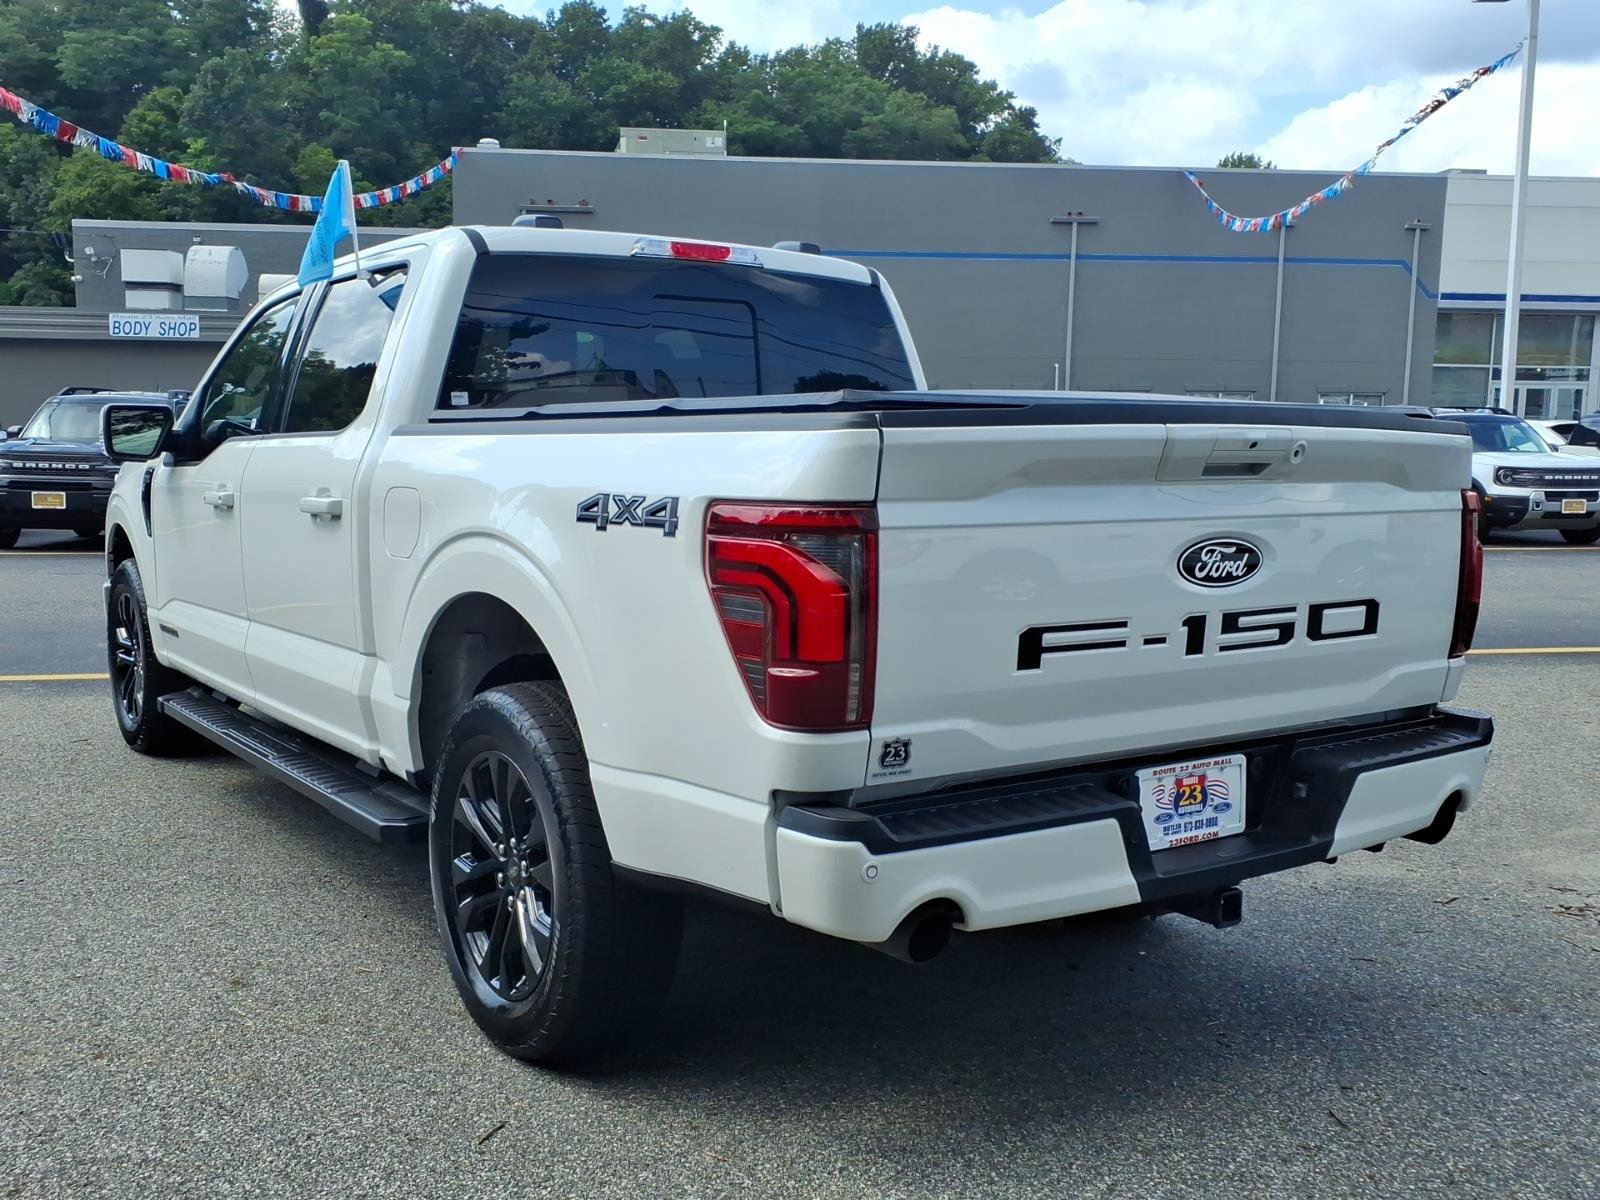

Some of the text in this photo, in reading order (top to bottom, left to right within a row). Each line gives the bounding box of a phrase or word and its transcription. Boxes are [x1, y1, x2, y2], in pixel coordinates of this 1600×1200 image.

[112, 320, 198, 337] BODY SHOP
[12, 462, 90, 470] BRONCO
[1194, 545, 1249, 579] Ford
[1015, 597, 1381, 673] F-150
[885, 747, 906, 761] 23
[1152, 767, 1176, 776] ROUTE
[1192, 761, 1212, 770] AUTO
[1213, 758, 1232, 766] MALL
[1179, 784, 1203, 806] 23
[1168, 830, 1220, 847] 23FORD.COM
